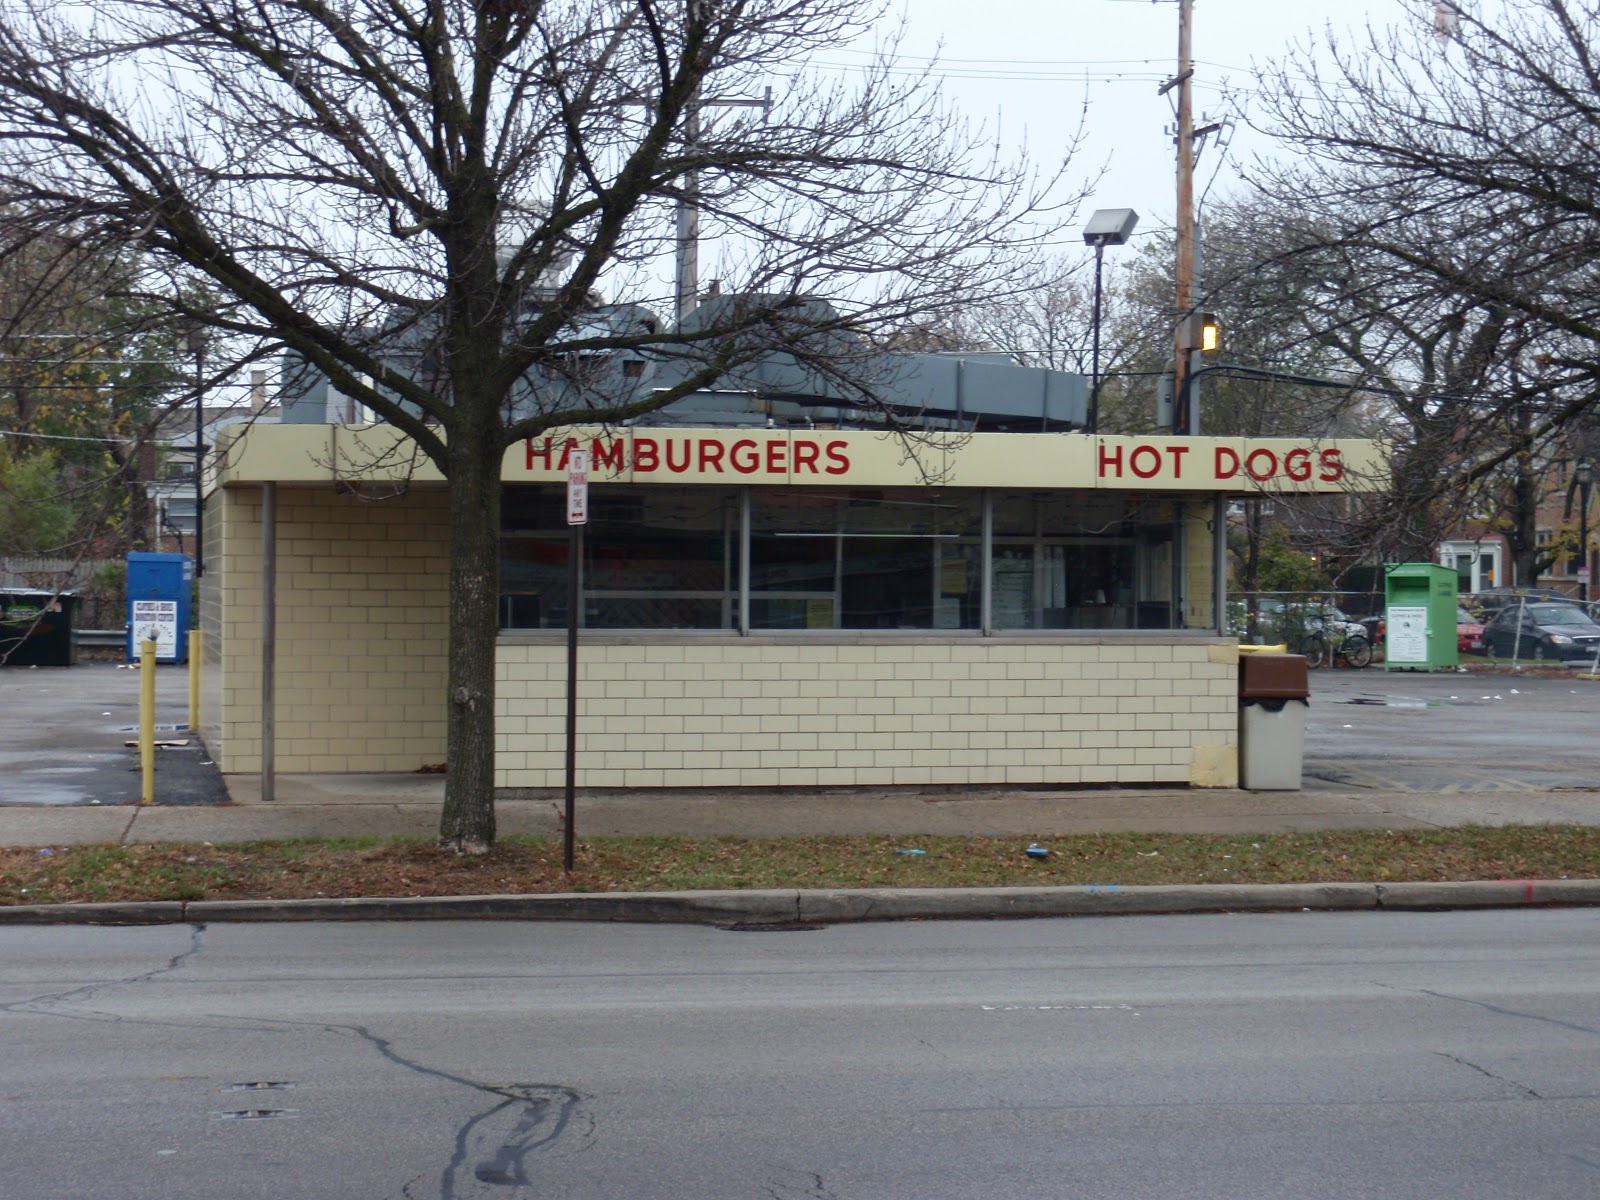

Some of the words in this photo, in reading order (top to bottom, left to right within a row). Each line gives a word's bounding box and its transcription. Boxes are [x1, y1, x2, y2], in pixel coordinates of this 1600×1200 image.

[525, 437, 850, 476] HAMBURGERS
[1098, 445, 1190, 479] HOT
[1215, 447, 1344, 482] DOGS
